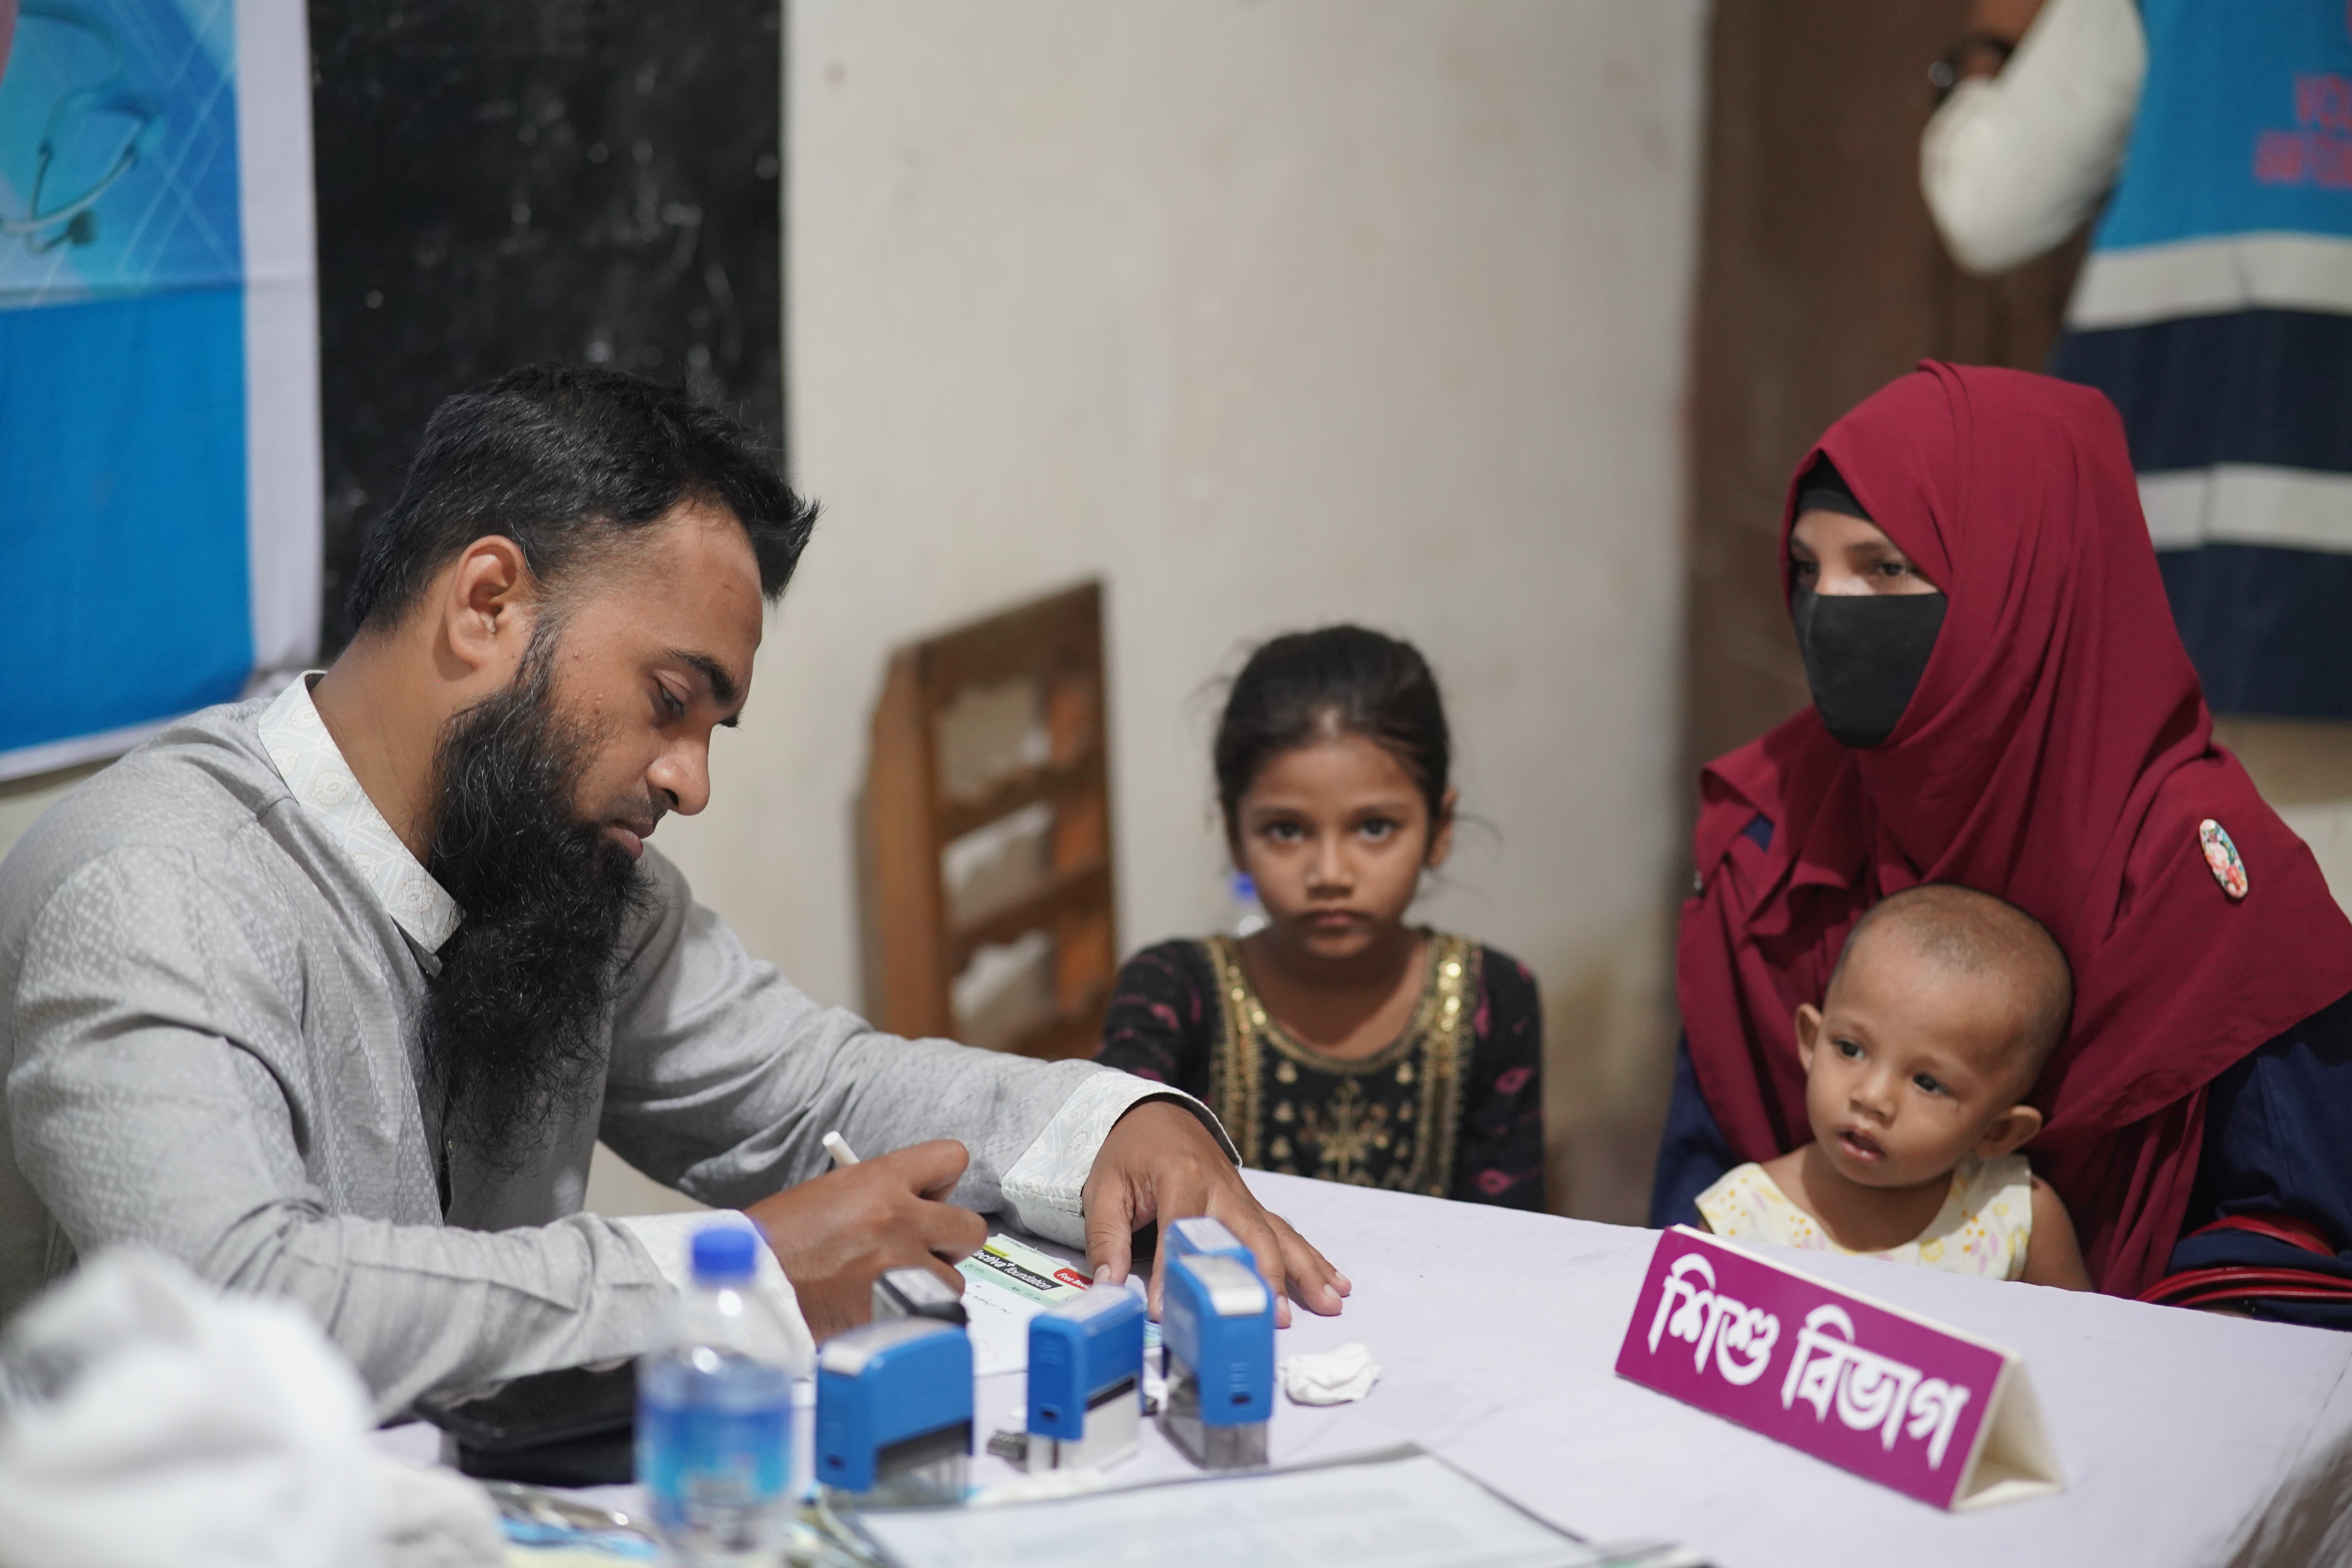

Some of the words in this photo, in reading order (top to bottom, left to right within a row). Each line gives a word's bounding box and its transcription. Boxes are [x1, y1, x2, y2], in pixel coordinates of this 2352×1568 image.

[1057, 1272, 1074, 1282] Free
[1648, 1253, 1780, 1385] শিশু
[1780, 1304, 1971, 1471] বিভাগ
